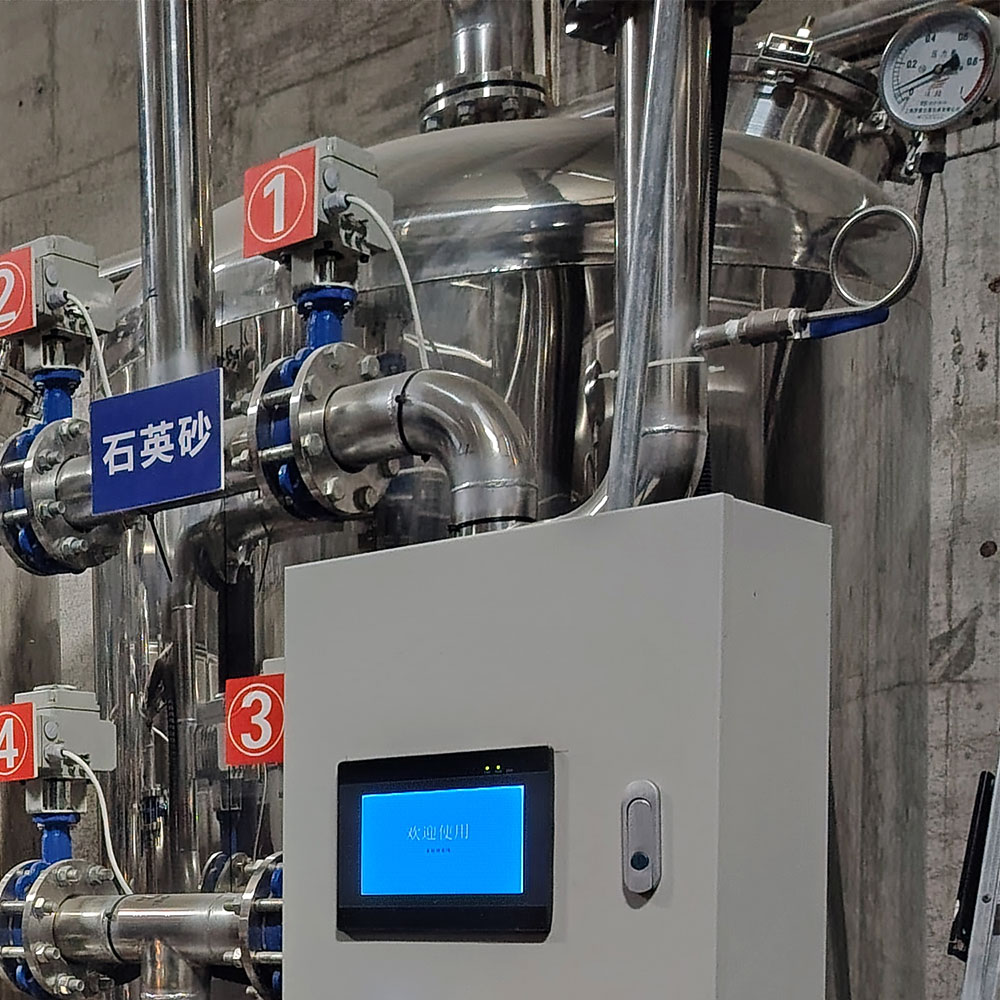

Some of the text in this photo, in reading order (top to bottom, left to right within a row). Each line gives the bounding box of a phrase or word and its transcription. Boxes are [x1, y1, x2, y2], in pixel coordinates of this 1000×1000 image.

[263, 173, 285, 233] 1
[102, 410, 212, 475] 石英砂
[241, 690, 273, 749] 3
